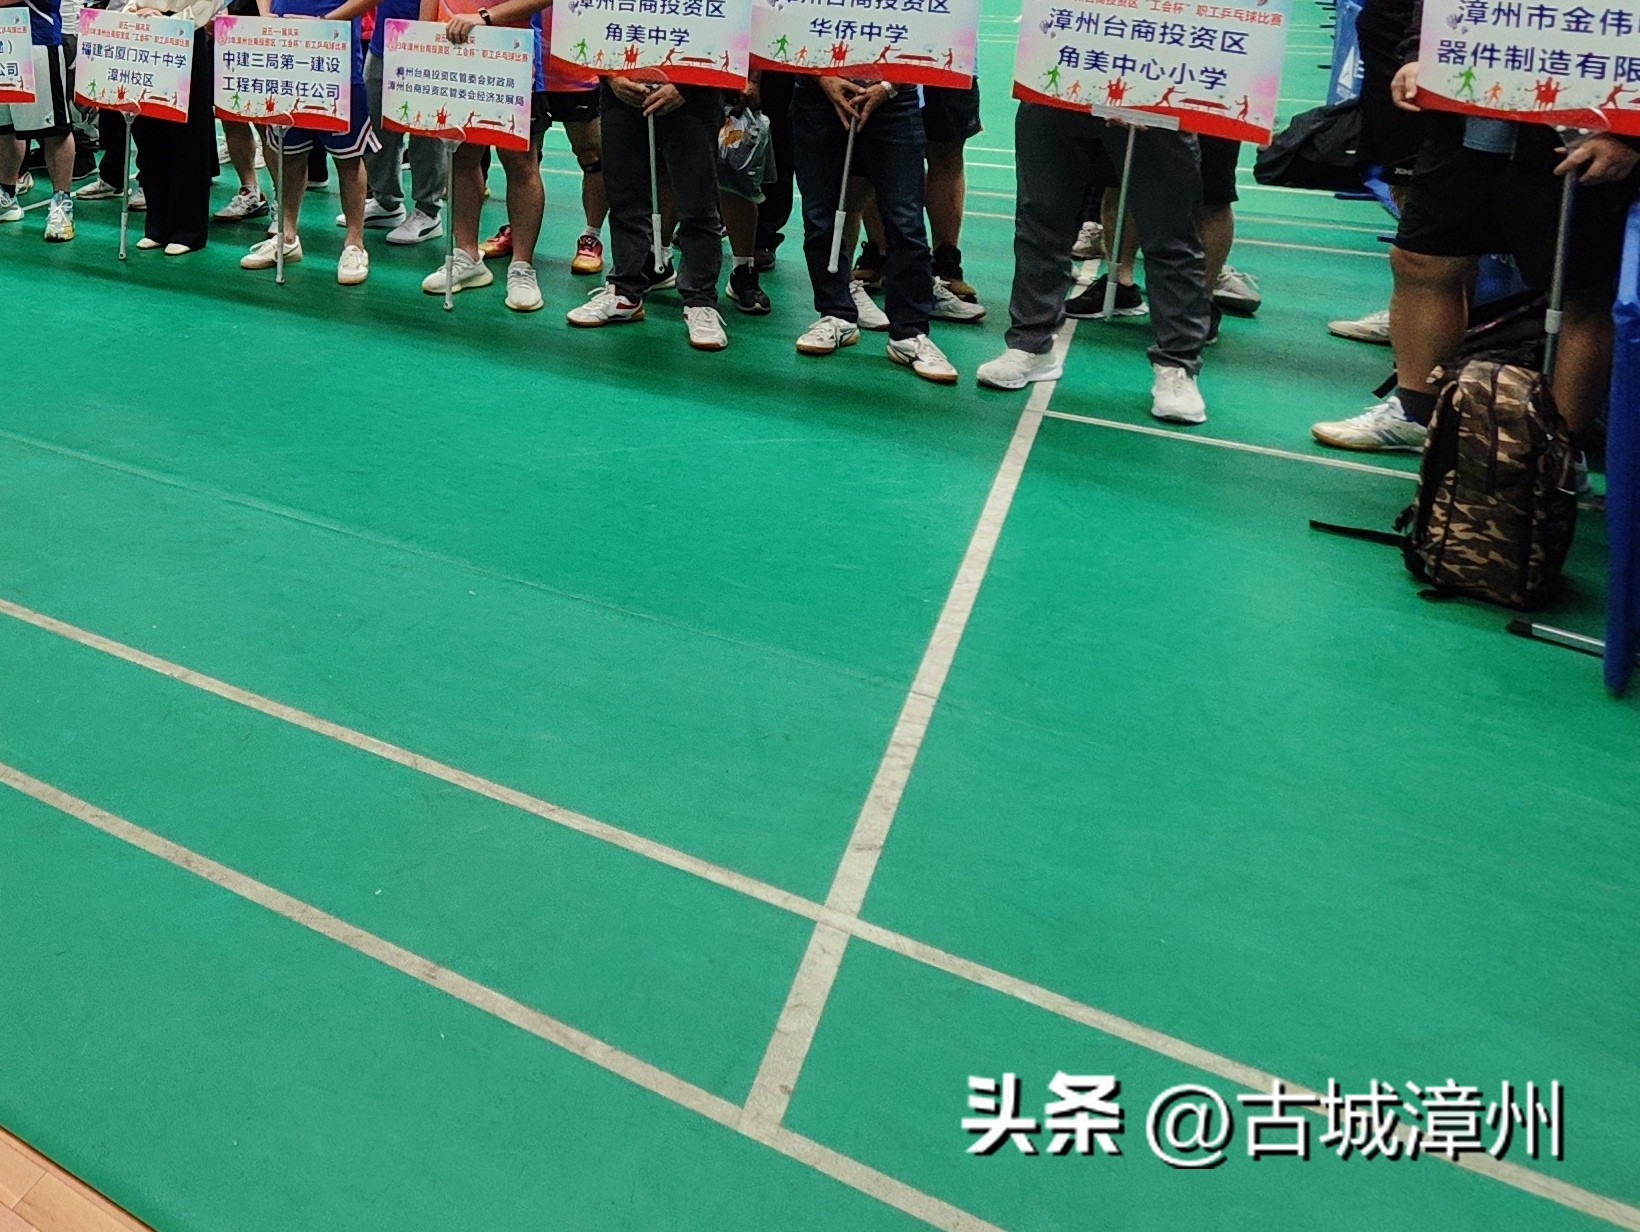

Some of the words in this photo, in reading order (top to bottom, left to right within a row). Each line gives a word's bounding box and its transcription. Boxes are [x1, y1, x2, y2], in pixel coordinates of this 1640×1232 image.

[604, 22, 690, 47] 角美中学
[809, 17, 909, 44] 华侨中学
[1047, 7, 1250, 55] 漳州台商投资区
[81, 41, 187, 68] 福建省厦门双十中学
[222, 49, 341, 74] 中建三局第一建设
[1057, 44, 1228, 91] 角美中心小学
[107, 68, 155, 88] 漳州校区
[222, 76, 341, 101] 工程有限责任公司
